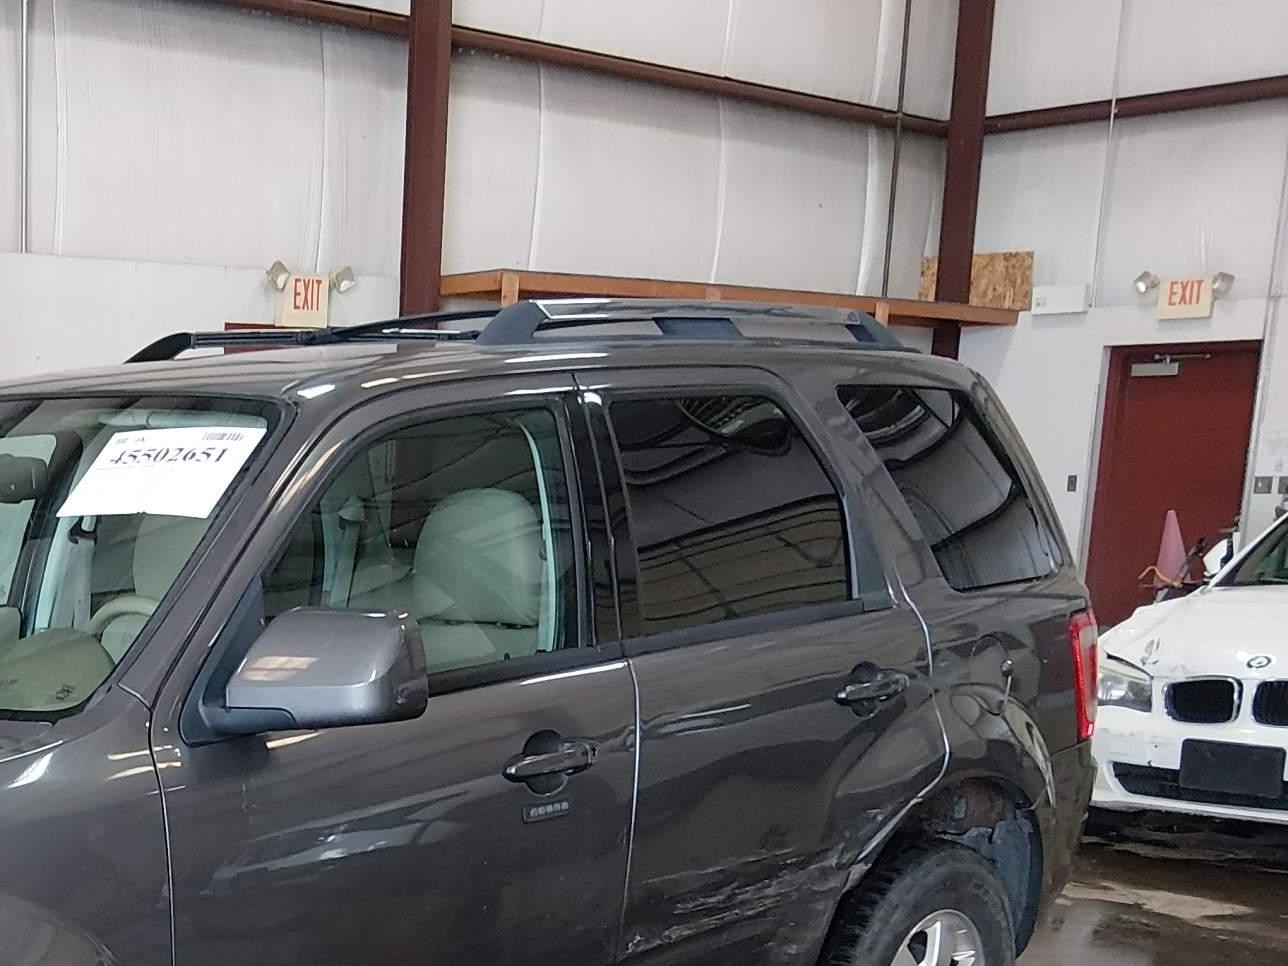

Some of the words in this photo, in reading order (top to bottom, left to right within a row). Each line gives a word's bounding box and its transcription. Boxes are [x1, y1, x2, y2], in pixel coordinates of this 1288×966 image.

[293, 278, 323, 311] EXIT
[1168, 279, 1205, 306] EXIT
[109, 446, 229, 465] 45502651
